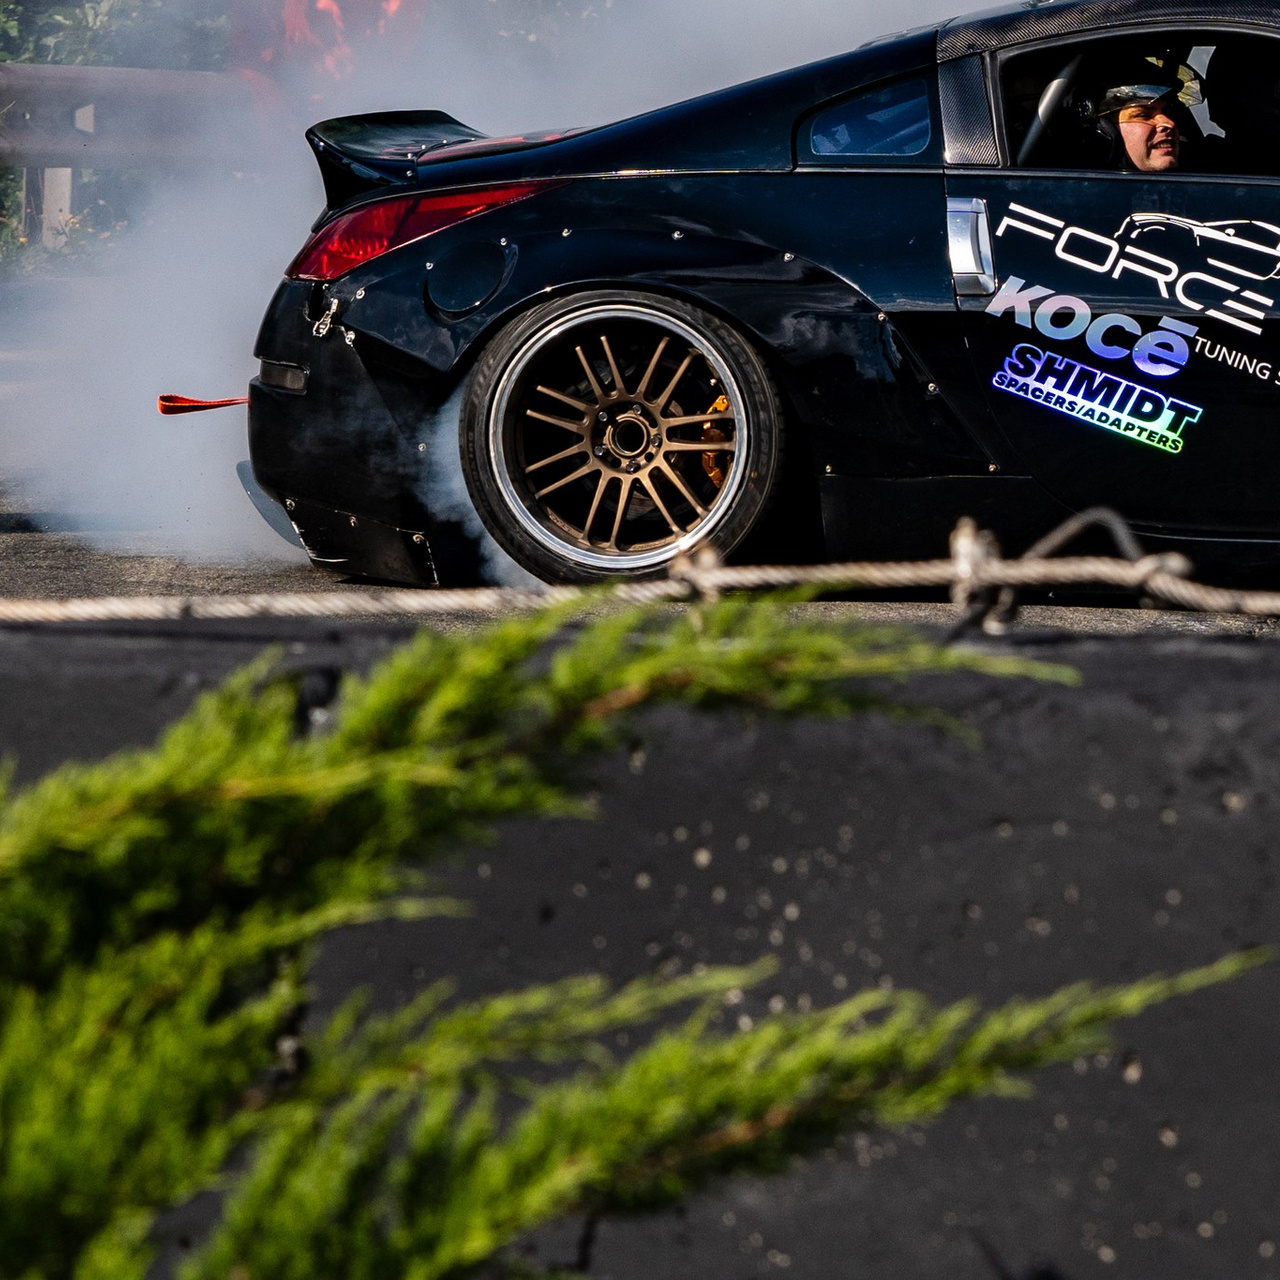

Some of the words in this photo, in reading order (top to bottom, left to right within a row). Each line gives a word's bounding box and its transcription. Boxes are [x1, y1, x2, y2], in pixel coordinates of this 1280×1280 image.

[995, 202, 1274, 335] FORCE
[1004, 343, 1203, 437] SHMIDT
[1194, 336, 1272, 380] TUNING
[993, 372, 1183, 453] SPACERS/ADAPTERS
